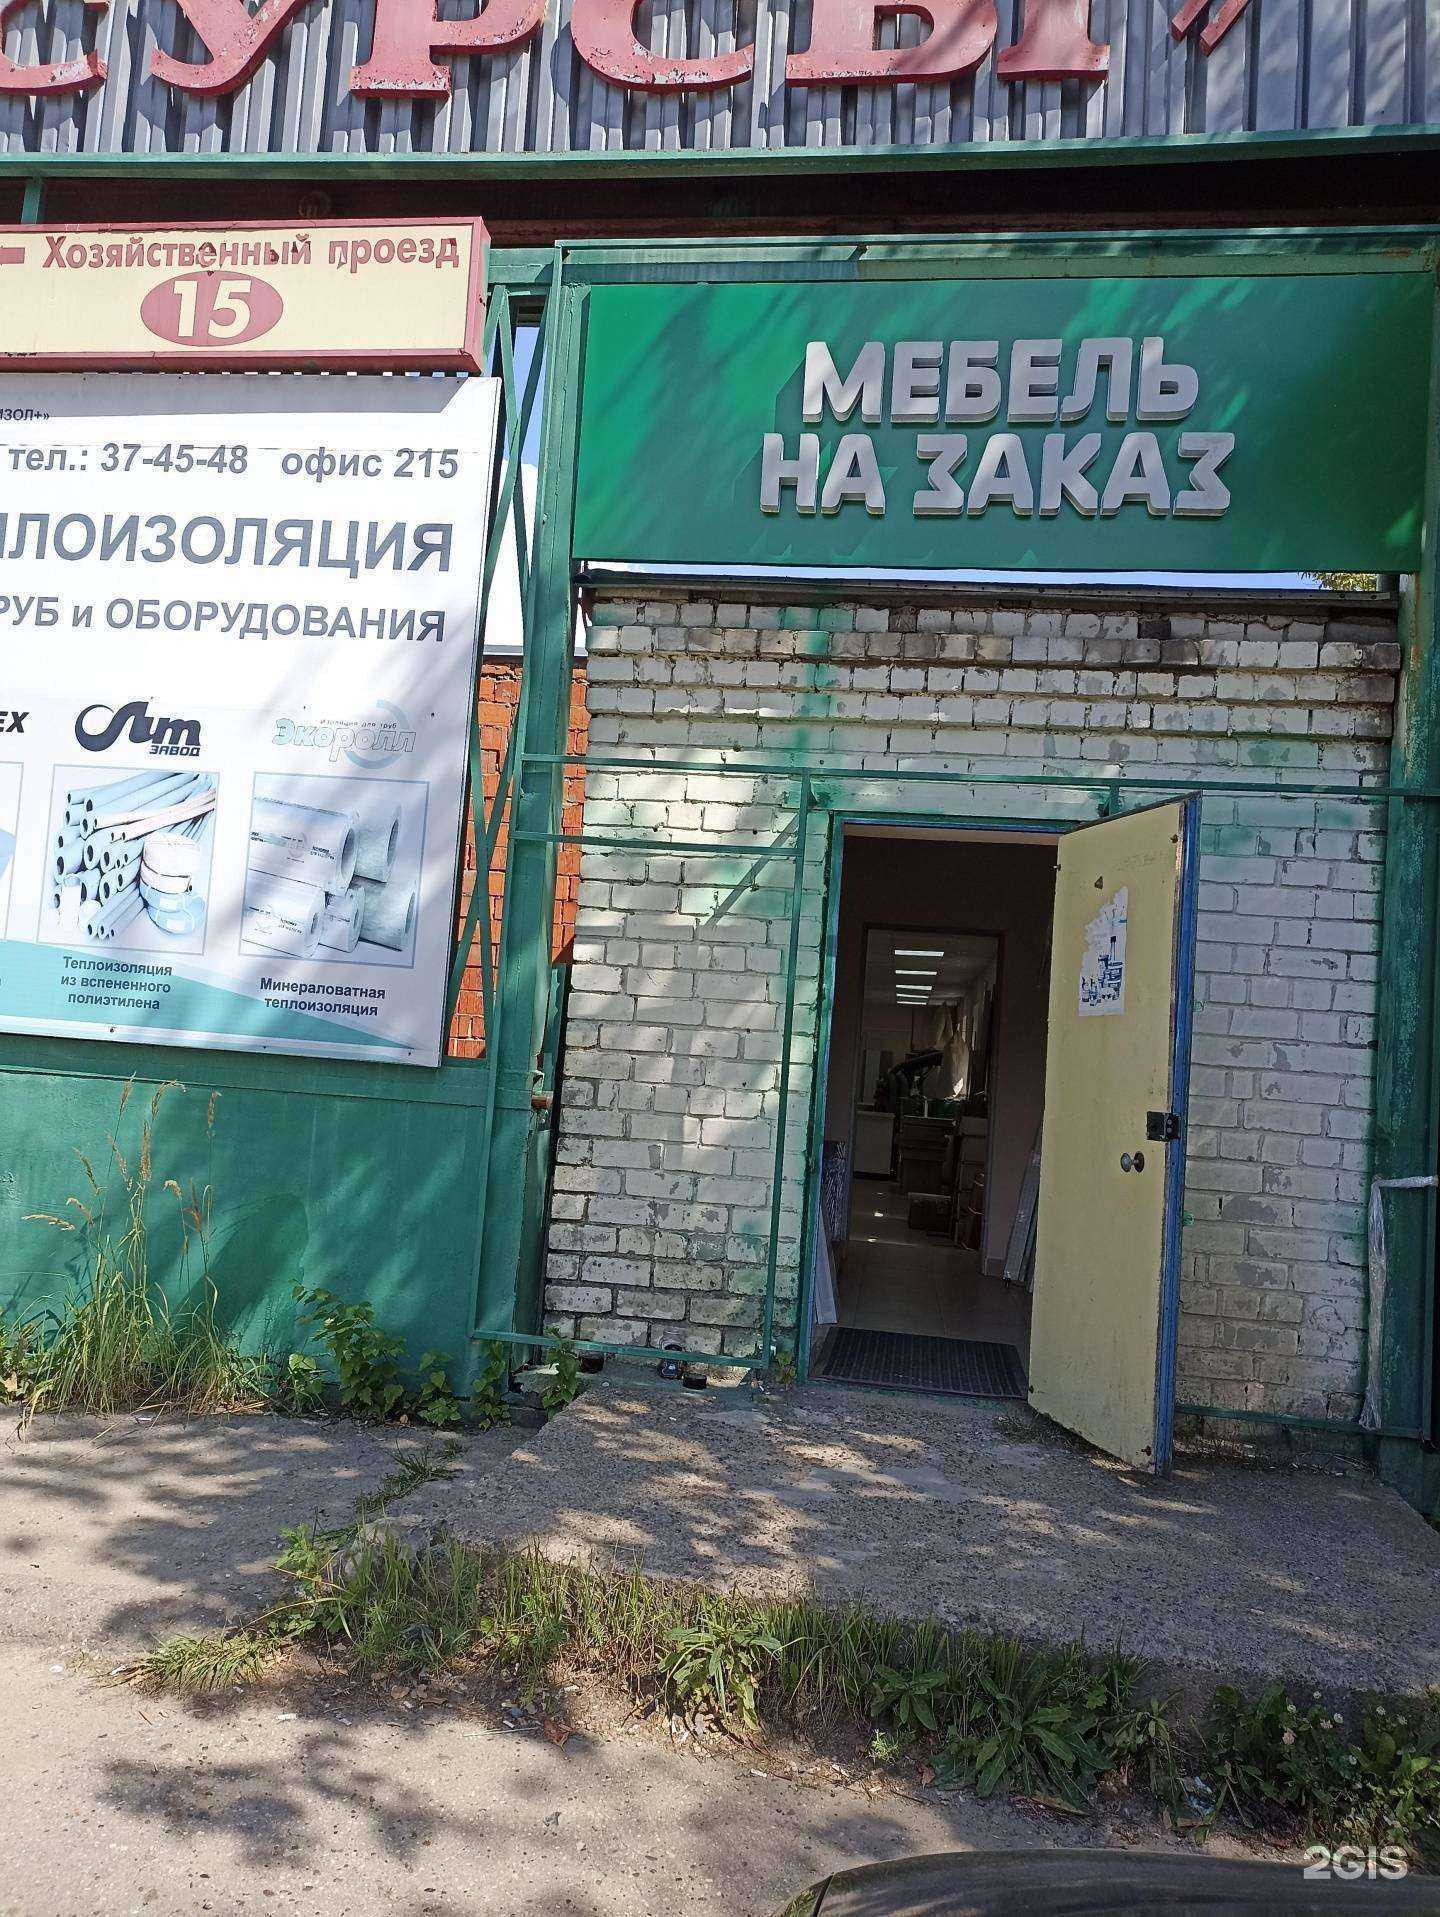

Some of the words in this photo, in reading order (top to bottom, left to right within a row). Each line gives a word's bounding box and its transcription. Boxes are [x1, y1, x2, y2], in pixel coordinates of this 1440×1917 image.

[43, 232, 312, 269] Хозяйственный
[328, 237, 459, 273] проезд
[172, 280, 252, 338] 15
[802, 336, 1199, 424] МЕБЕЛЬ
[8, 448, 88, 471] тел.:
[101, 442, 248, 474] 37-45-48
[281, 447, 382, 482] офис
[393, 448, 459, 478] 215
[760, 433, 886, 515] НА
[912, 433, 1236, 517] ЗАКАЗ
[72, 605, 93, 627] и
[106, 598, 446, 641] ОБОРУДОВАНИЯ
[149, 744, 201, 757] ЗАВОД
[63, 955, 173, 977] Теплоизоляция
[60, 975, 77, 986] из
[80, 977, 171, 994] вспененного
[260, 977, 386, 1000] Минераловатная
[68, 993, 160, 1010] полиэтилена
[265, 997, 378, 1016] теплоизоляция
